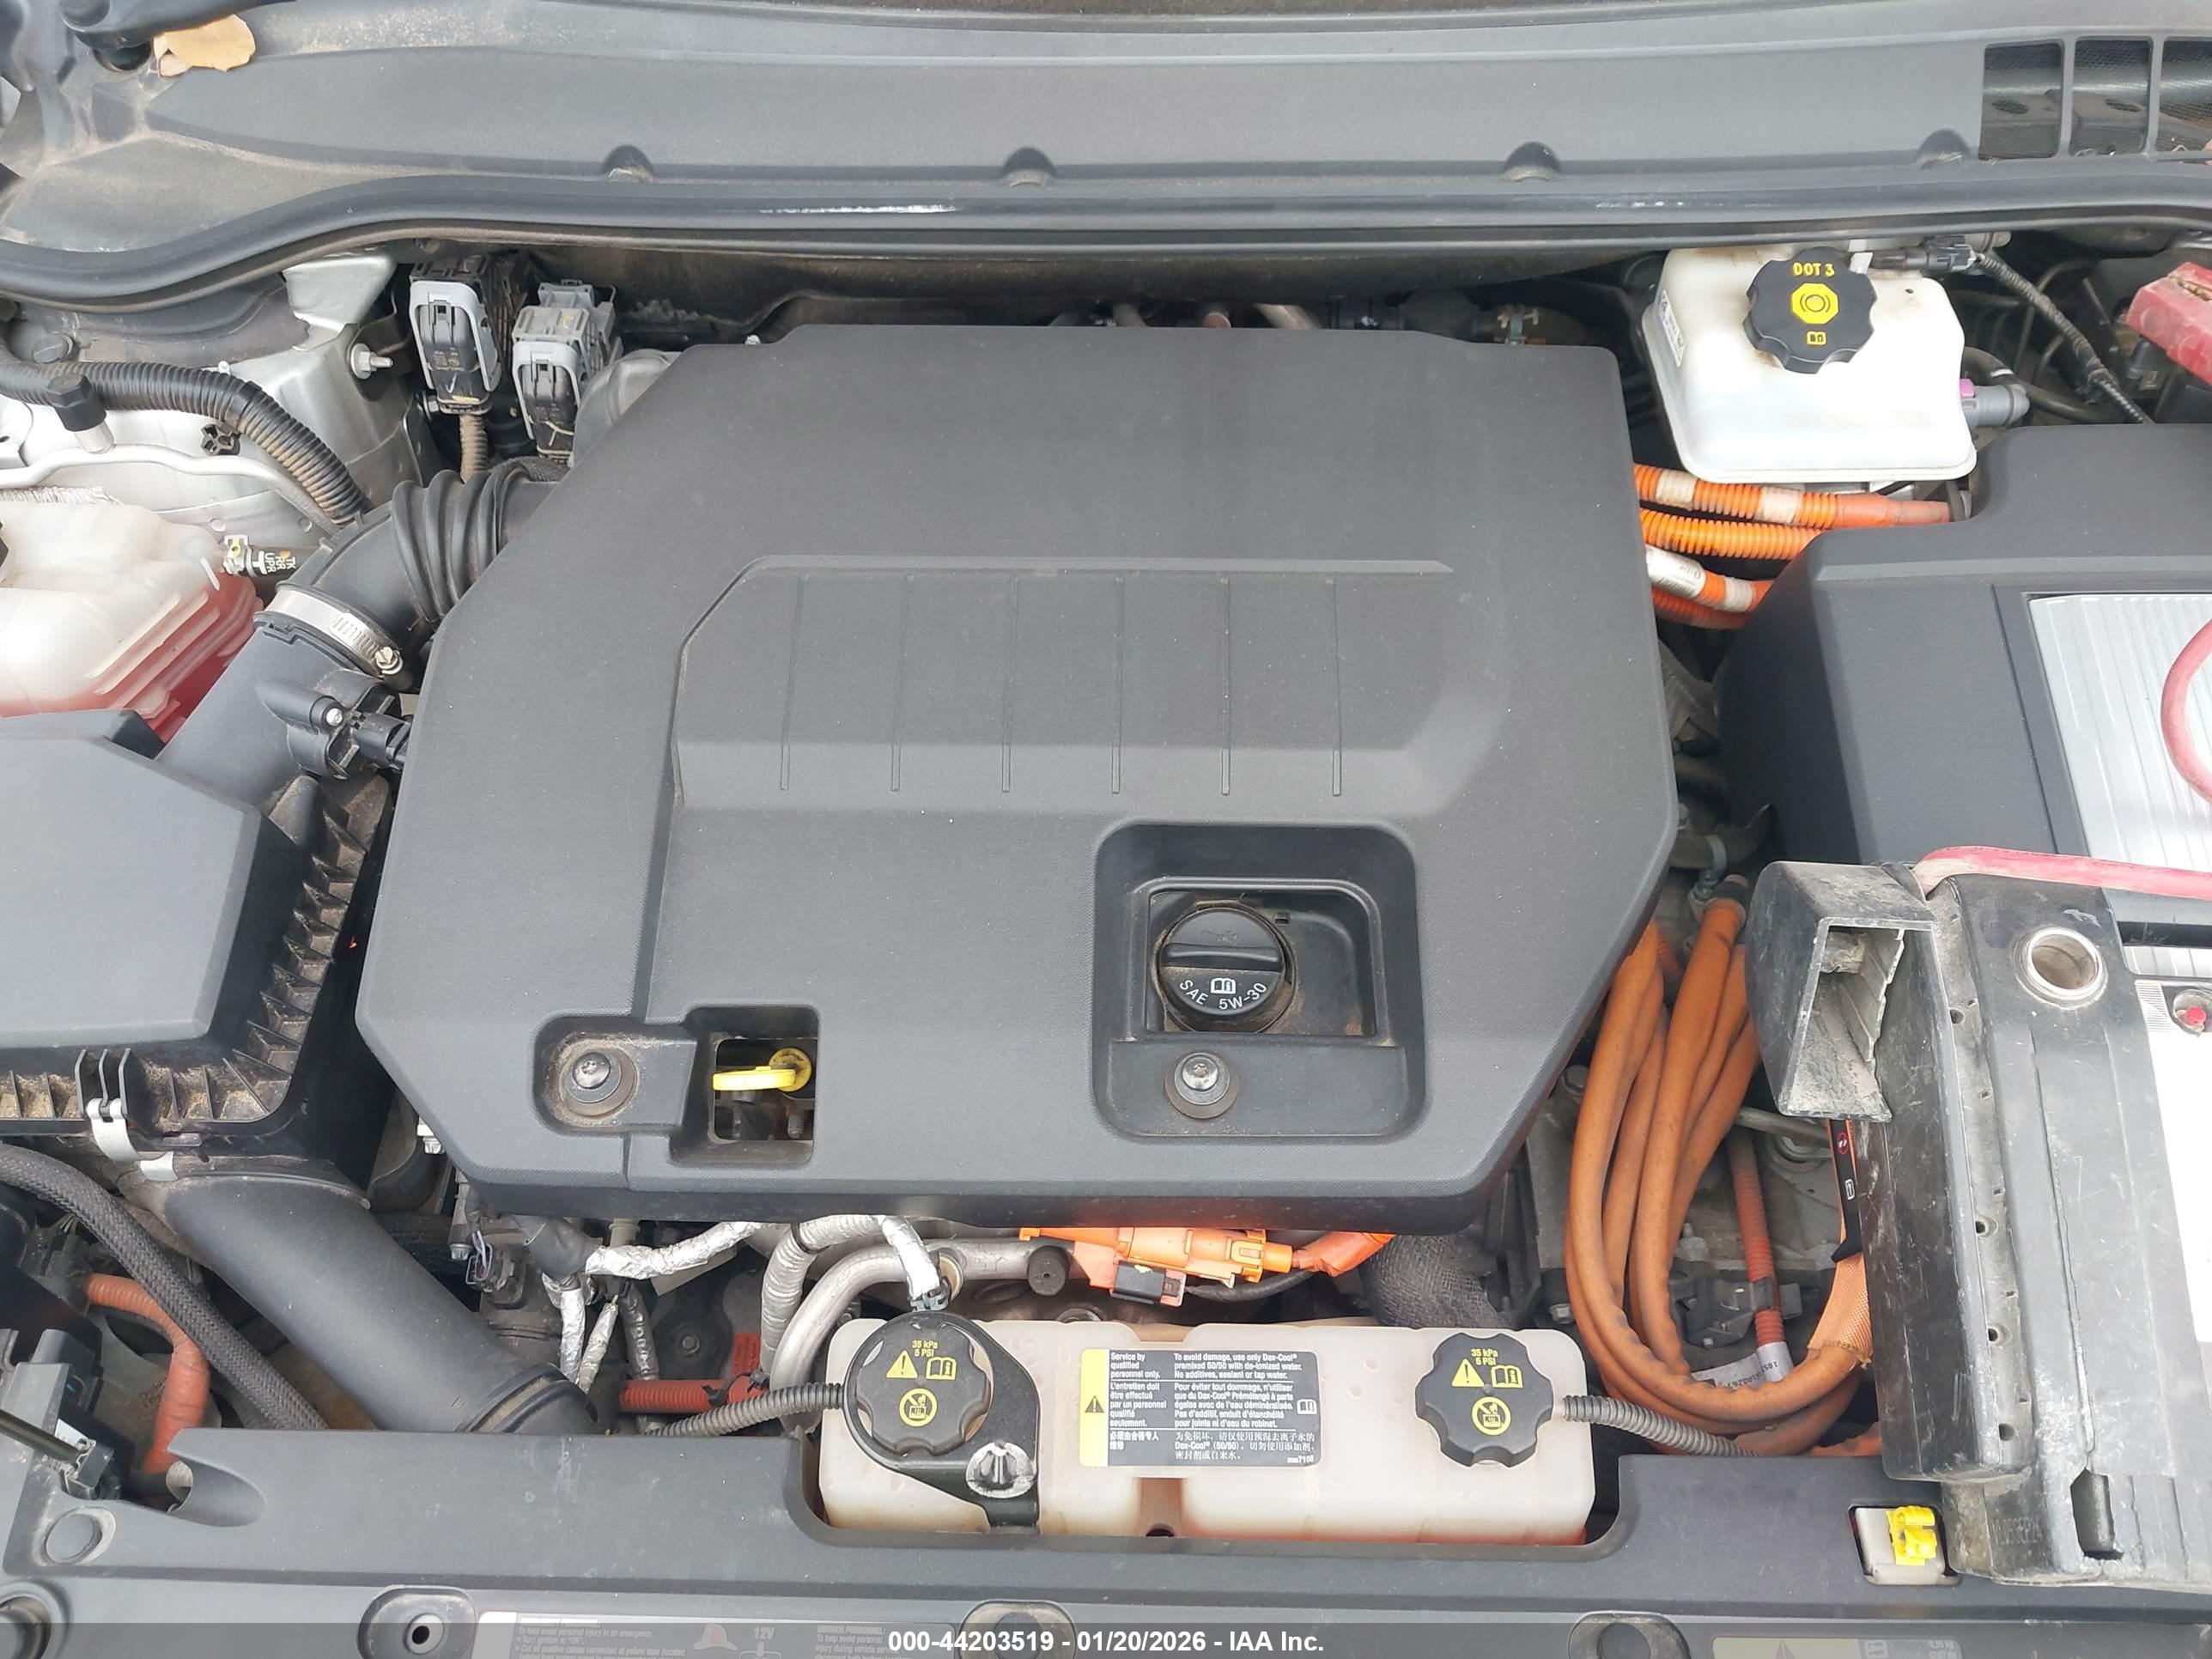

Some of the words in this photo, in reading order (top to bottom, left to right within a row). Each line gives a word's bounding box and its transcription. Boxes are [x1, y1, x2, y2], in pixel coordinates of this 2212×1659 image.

[1793, 262, 1822, 276] DOT
[1825, 264, 1835, 276] 3
[265, 552, 276, 573] UPR
[1179, 979, 1209, 1006] SAE
[1218, 982, 1267, 1010] 5W-30
[912, 1340, 922, 1349] 35
[924, 1340, 939, 1349] kPa
[1110, 1352, 1136, 1361] Service
[1137, 1353, 1146, 1362] by
[1247, 1353, 1261, 1362] only
[1471, 1348, 1482, 1357] 35
[1483, 1349, 1498, 1358] kPa
[1110, 1361, 1140, 1370] qualified
[1175, 1362, 1206, 1370] premixed
[1483, 1358, 1497, 1366] PSI
[1110, 1370, 1144, 1378] personnel
[1254, 1371, 1266, 1380] tap
[1146, 1382, 1160, 1390] doit
[1212, 1382, 1226, 1391] tout
[1277, 1393, 1294, 1402] parts
[1133, 1401, 1167, 1409] personnel
[1175, 1409, 1188, 1418] Pas
[1175, 1420, 1191, 1429] pour
[1191, 1419, 1211, 1429] joints
[754, 1626, 775, 1639] 12V
